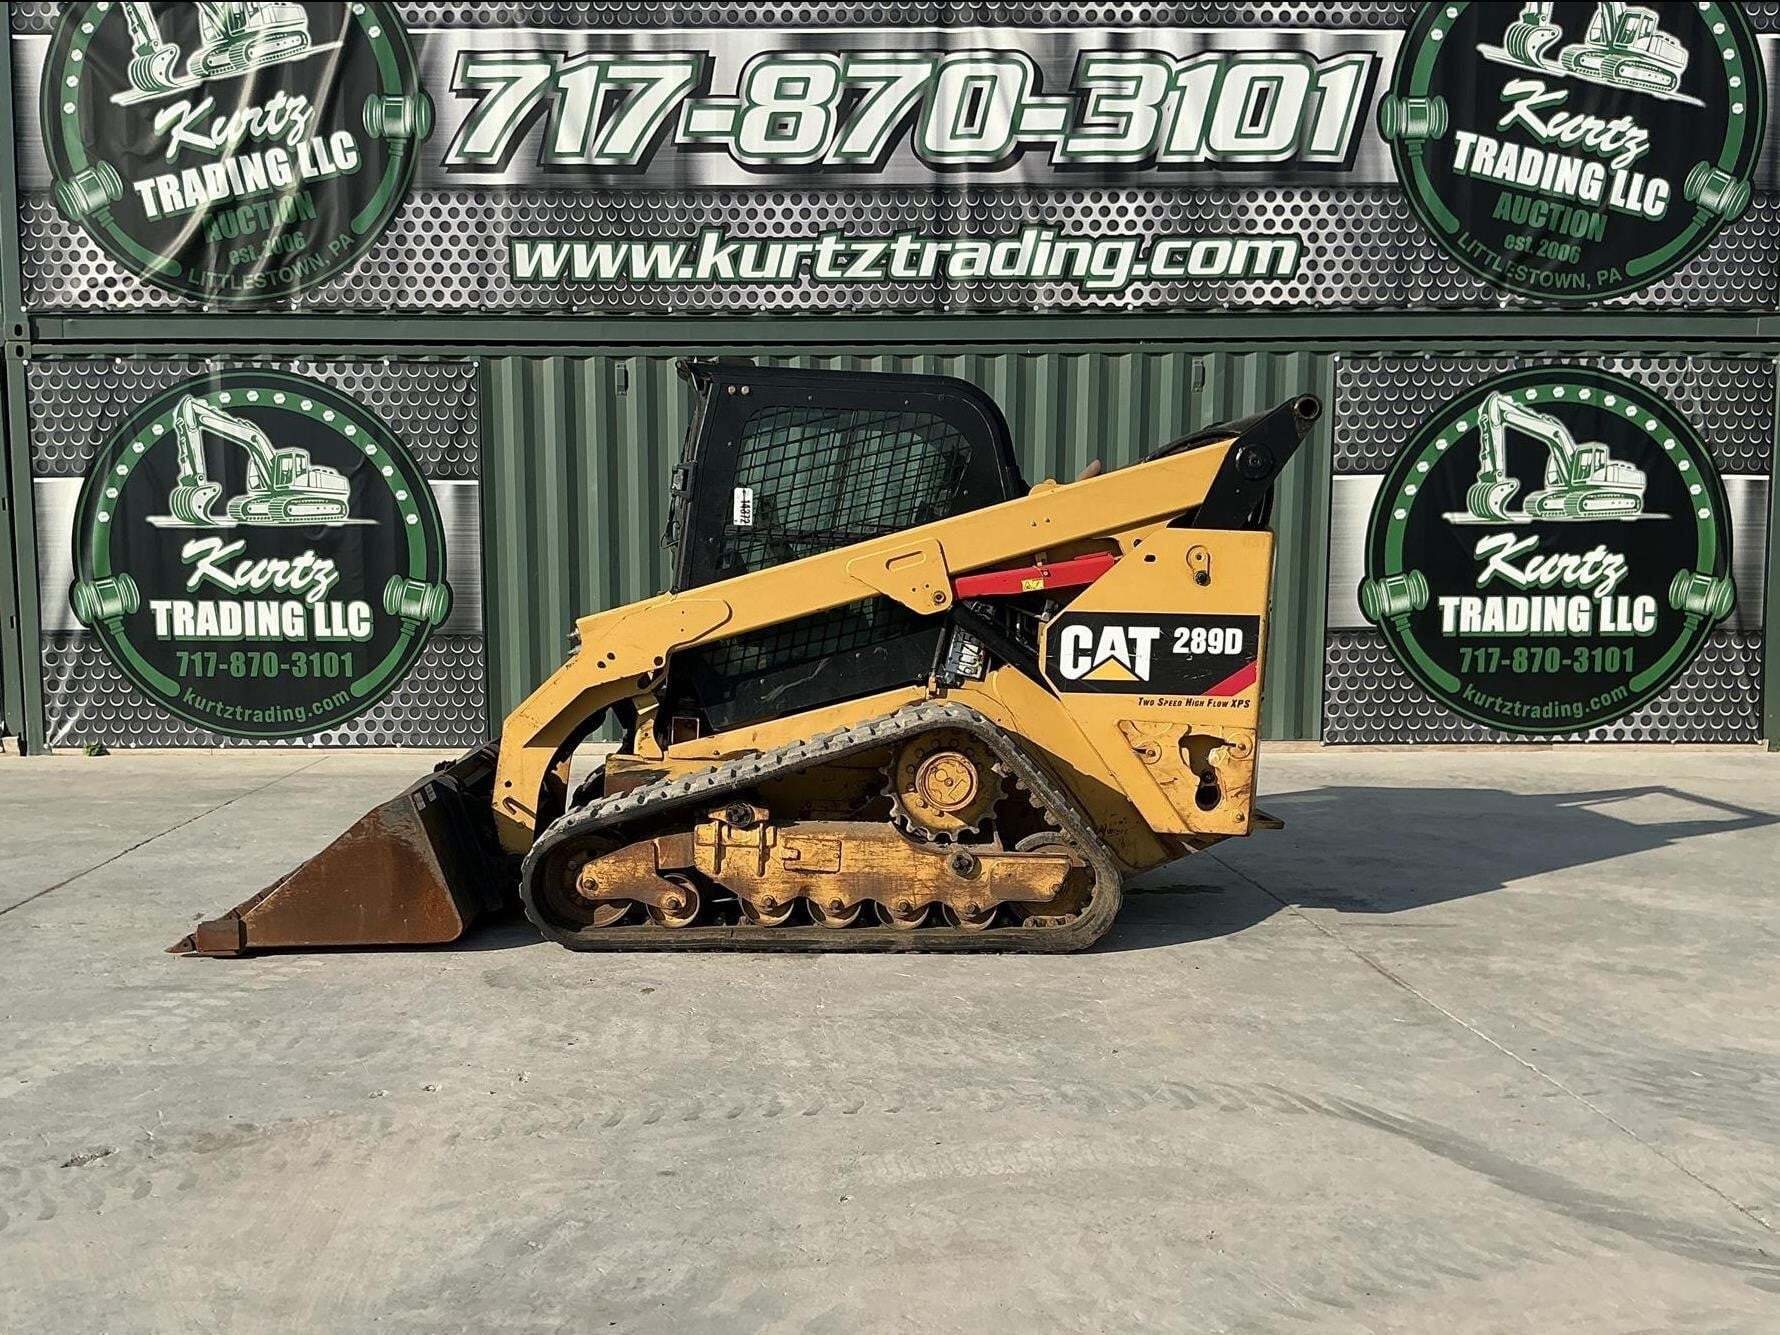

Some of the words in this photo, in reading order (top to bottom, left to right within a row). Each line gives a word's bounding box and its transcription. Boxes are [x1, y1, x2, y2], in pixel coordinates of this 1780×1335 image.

[154, 91, 315, 161] Kurtz
[446, 50, 1375, 170] 717-870-3101
[1499, 78, 1651, 171] Kurtz
[133, 147, 294, 219] TRADING
[296, 131, 360, 180] LLC
[1452, 130, 1607, 202] TRADING
[1606, 168, 1672, 218] LLC
[202, 191, 317, 243] AUCTION
[1492, 191, 1608, 243] AUCTION
[328, 232, 355, 257] PA
[510, 228, 1301, 292] www.kurtztrading.com
[1596, 267, 1622, 286] PA
[181, 536, 339, 604] Kurtz
[1474, 532, 1627, 599] Kurtz
[149, 601, 305, 640] TRADING
[313, 601, 373, 639] LLC
[1438, 596, 1593, 634] TRADING
[1599, 595, 1659, 634] LLC
[176, 651, 353, 678] 717-870-3101
[1059, 624, 1160, 682] CAT
[1172, 627, 1243, 655] 289D
[1459, 646, 1634, 673] 717-870-3101
[182, 687, 351, 723] kurtztrading.com
[1230, 699, 1250, 708] XPS
[1462, 683, 1628, 718] kurtztrading.com
